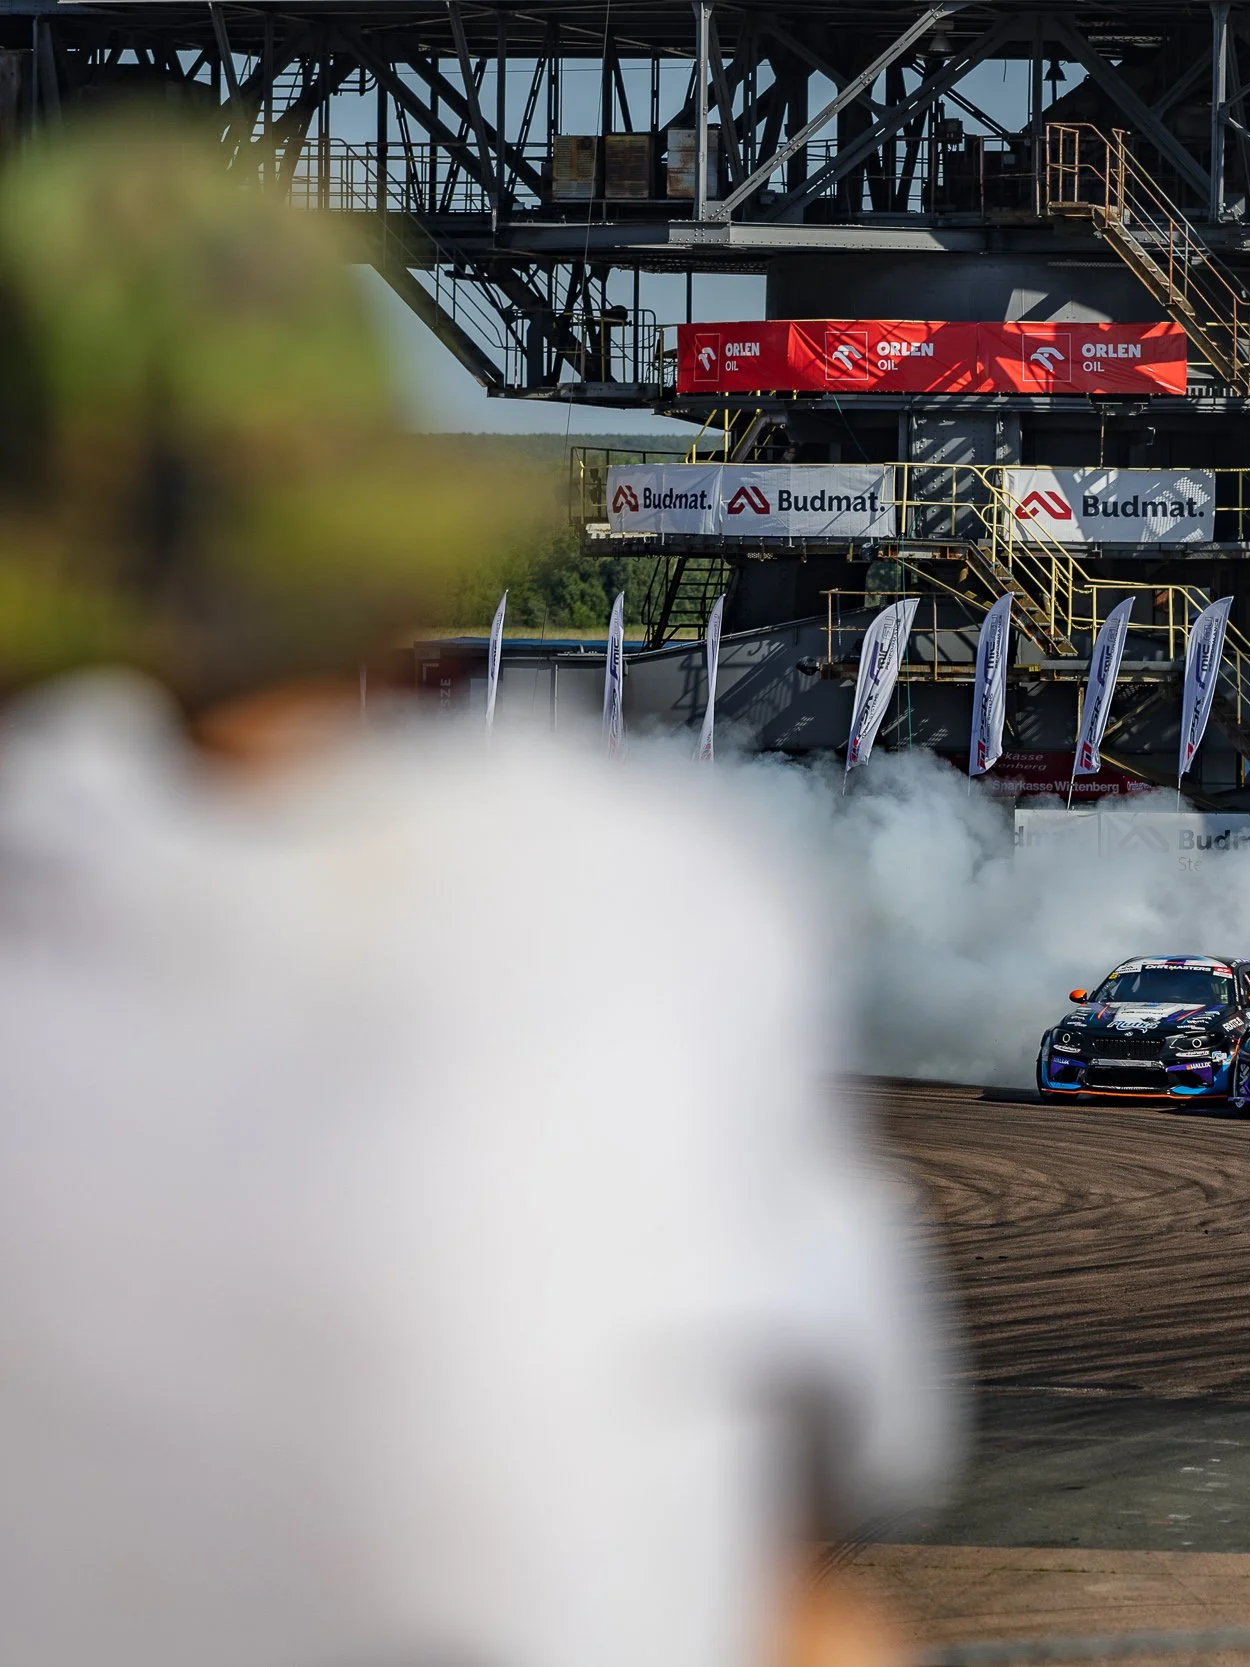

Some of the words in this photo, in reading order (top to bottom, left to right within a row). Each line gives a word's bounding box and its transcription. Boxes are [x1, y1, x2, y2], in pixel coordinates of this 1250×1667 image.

[725, 343, 760, 357] ORLEN
[877, 341, 934, 357] ORLEN
[1081, 343, 1141, 358] ORLEN
[725, 361, 739, 372] OIL
[878, 359, 898, 371] OIL
[1083, 361, 1104, 372] OIL
[644, 487, 712, 510] Budmat.
[778, 489, 886, 513] Budmat.
[1082, 495, 1205, 518] Budmat.
[1003, 752, 1044, 761] kasse
